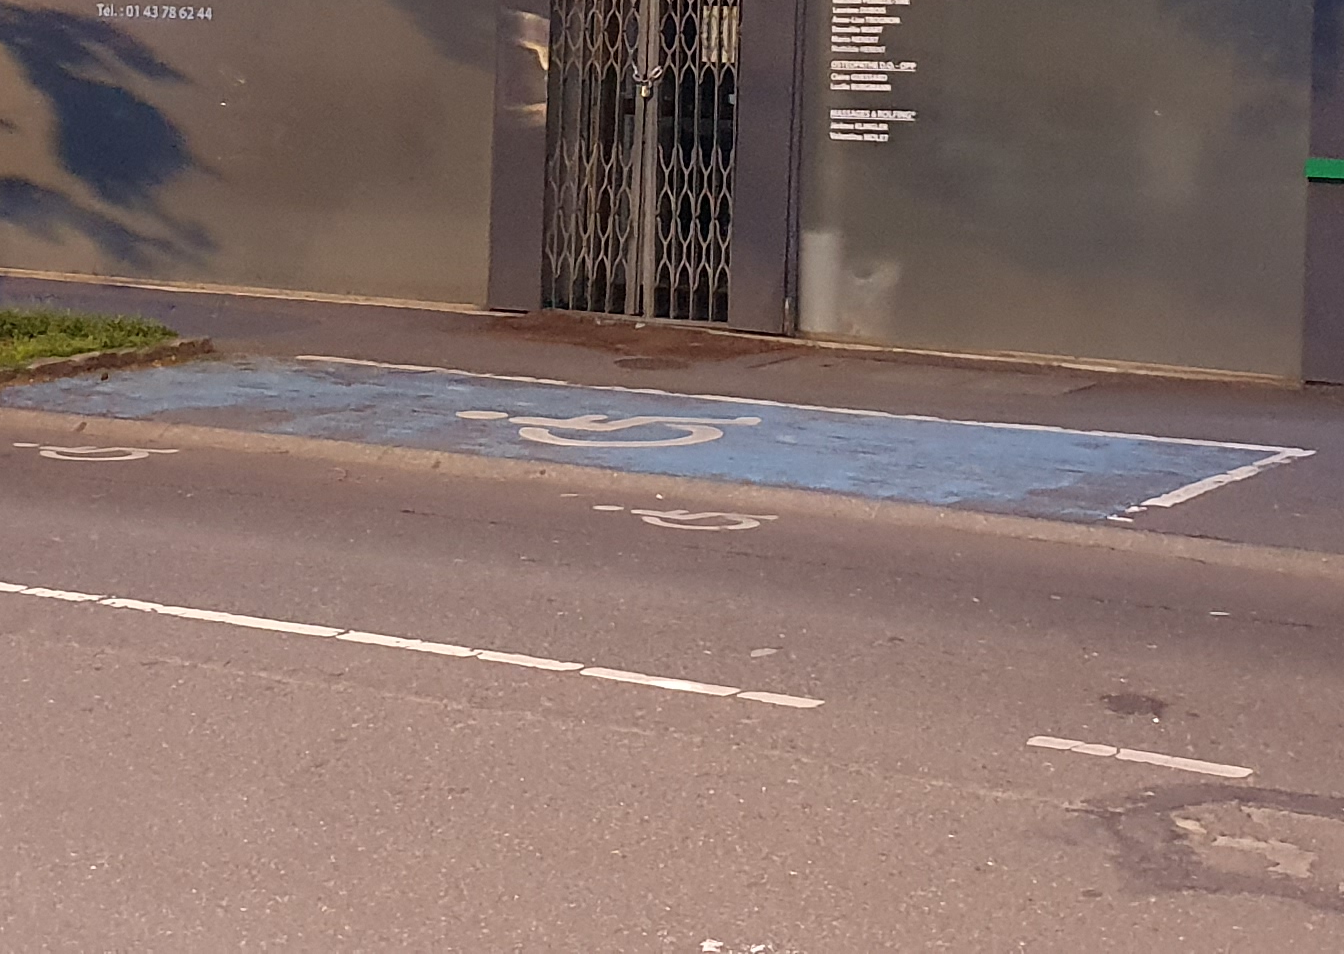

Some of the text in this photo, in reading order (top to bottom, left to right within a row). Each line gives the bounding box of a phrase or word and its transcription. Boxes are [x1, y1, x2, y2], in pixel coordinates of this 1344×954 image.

[126, 4, 140, 17] 01
[143, 5, 159, 19] 43
[162, 5, 176, 19] 78
[179, 6, 195, 20] 62
[197, 6, 213, 20] 44
